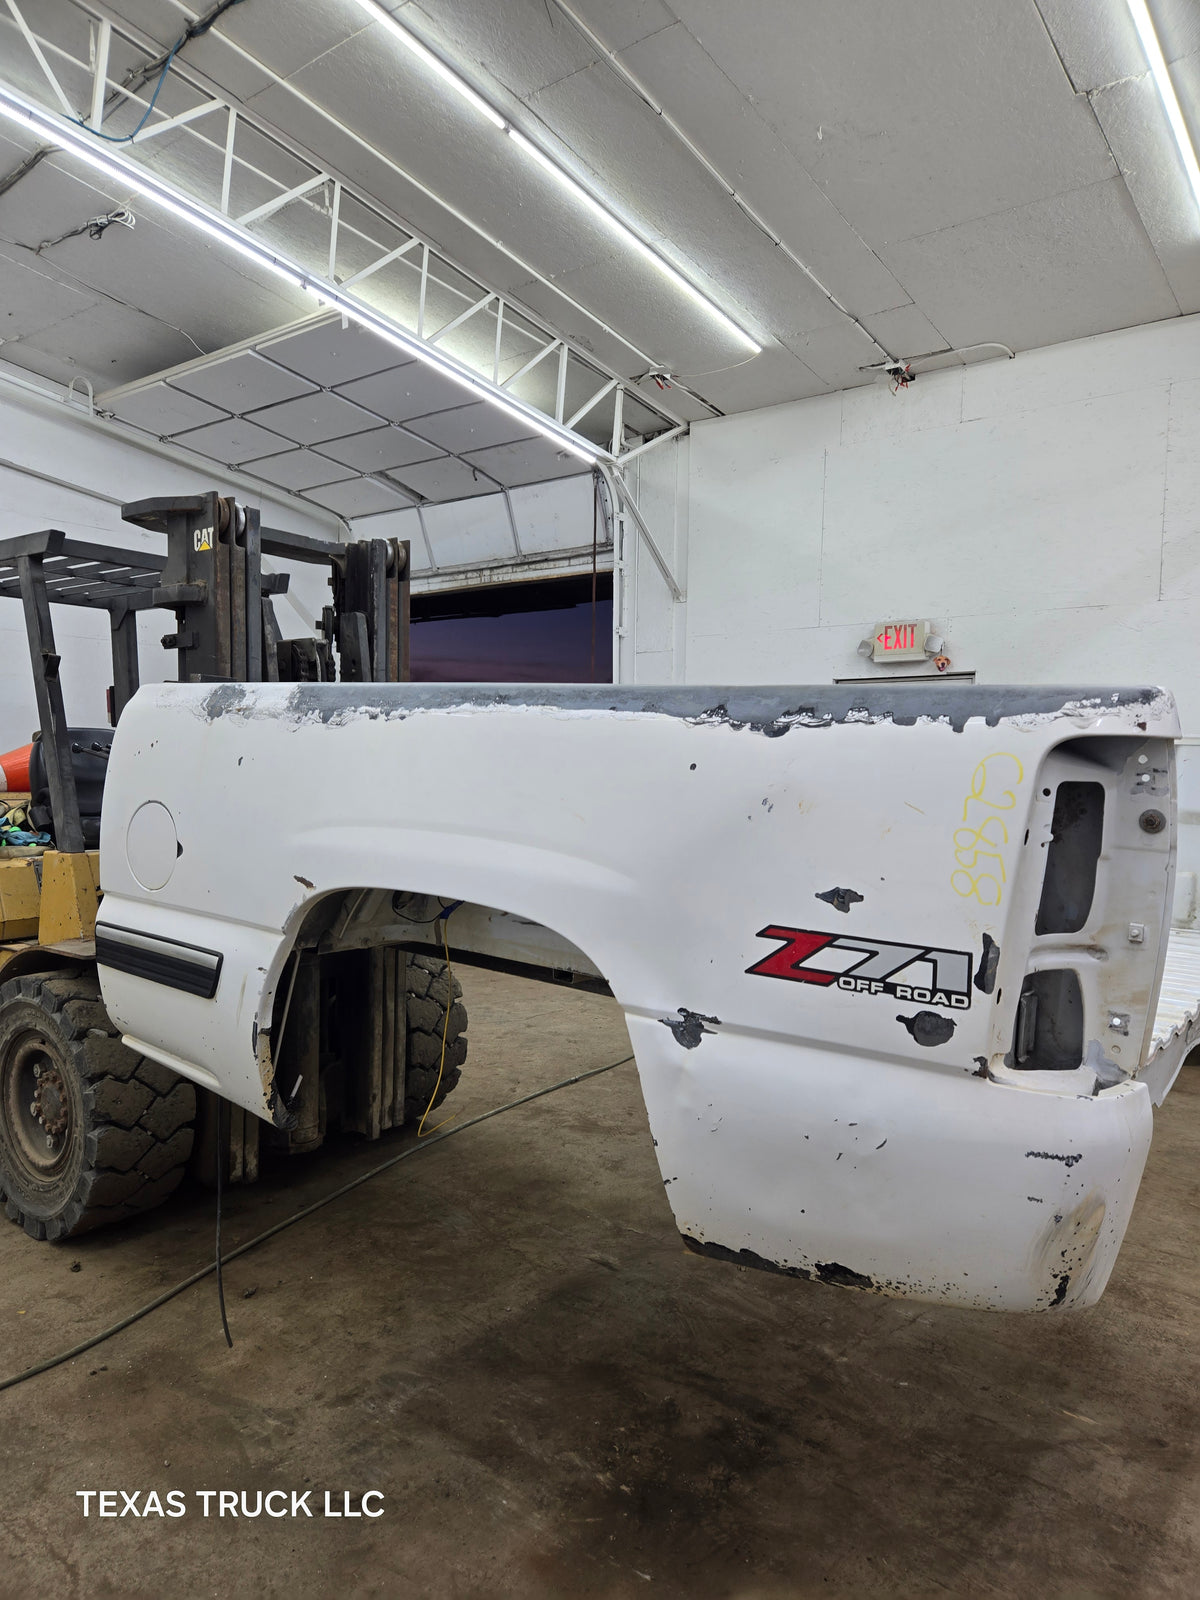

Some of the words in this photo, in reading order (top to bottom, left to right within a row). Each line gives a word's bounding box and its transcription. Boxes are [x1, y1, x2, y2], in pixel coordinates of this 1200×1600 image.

[193, 526, 214, 552] CAT
[884, 624, 917, 650] EXIT
[745, 925, 972, 993] Z71
[838, 977, 884, 994] OFF
[896, 986, 970, 1009] ROAD
